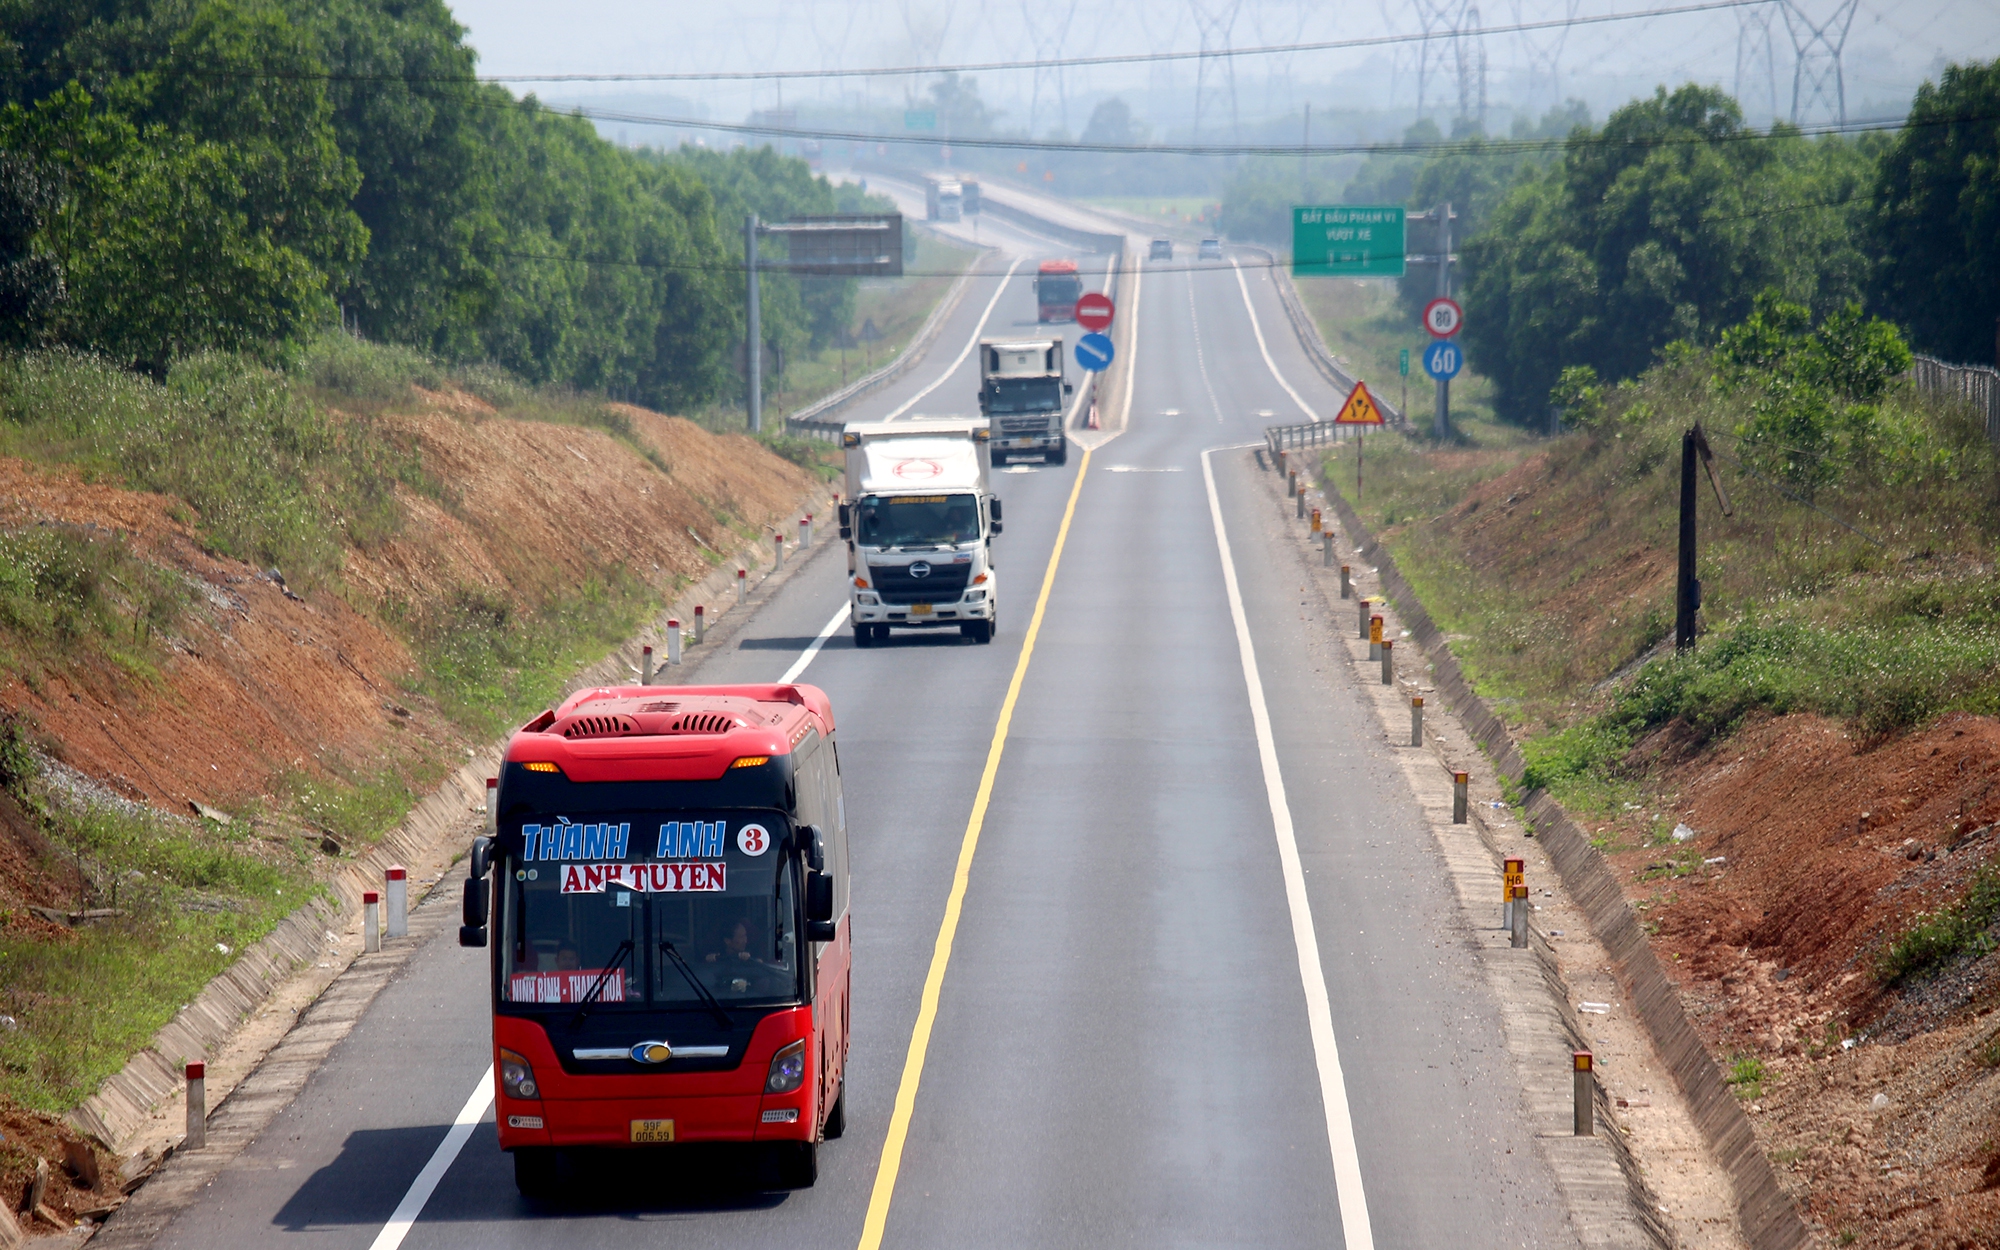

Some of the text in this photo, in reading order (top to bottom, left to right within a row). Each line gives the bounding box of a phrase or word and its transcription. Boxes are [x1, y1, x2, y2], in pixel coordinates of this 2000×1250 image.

[1384, 211, 1397, 224] VI
[1358, 228, 1372, 241] XE
[1435, 310, 1452, 328] 80
[1431, 347, 1456, 374] 60
[522, 815, 726, 861] THÀNH ANH
[745, 828, 763, 852] 3
[1506, 875, 1522, 886] H6
[537, 972, 561, 1003] BÌNH
[643, 1121, 661, 1131] 99F
[635, 1131, 670, 1142] 006.59
